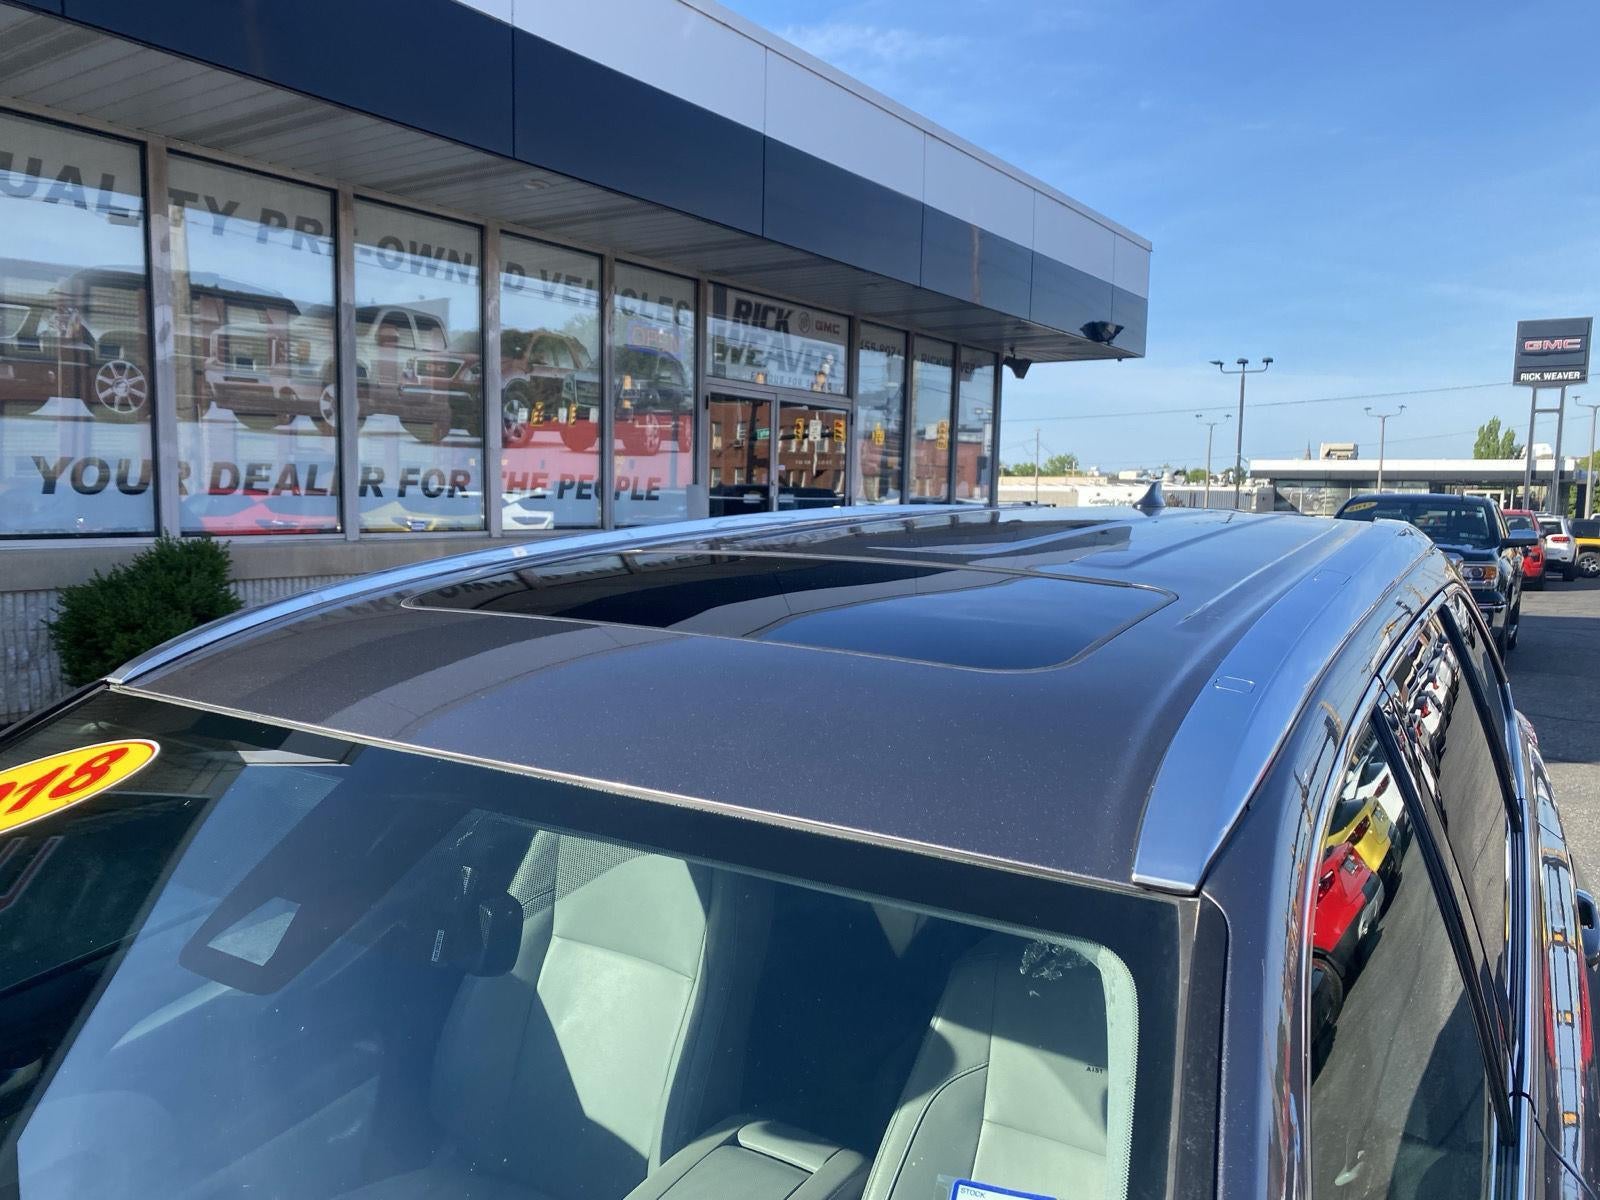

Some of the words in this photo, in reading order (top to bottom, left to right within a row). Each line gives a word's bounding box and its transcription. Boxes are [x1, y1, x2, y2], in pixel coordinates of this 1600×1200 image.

[733, 299, 794, 334] RICK
[1524, 338, 1581, 350] GMC
[1520, 372, 1541, 381] RICK
[1543, 371, 1580, 380] WEAVER
[397, 467, 471, 498] FOR
[502, 471, 547, 499] HE
[557, 473, 661, 501] PEPLE
[960, 1187, 986, 1199] STOCK
